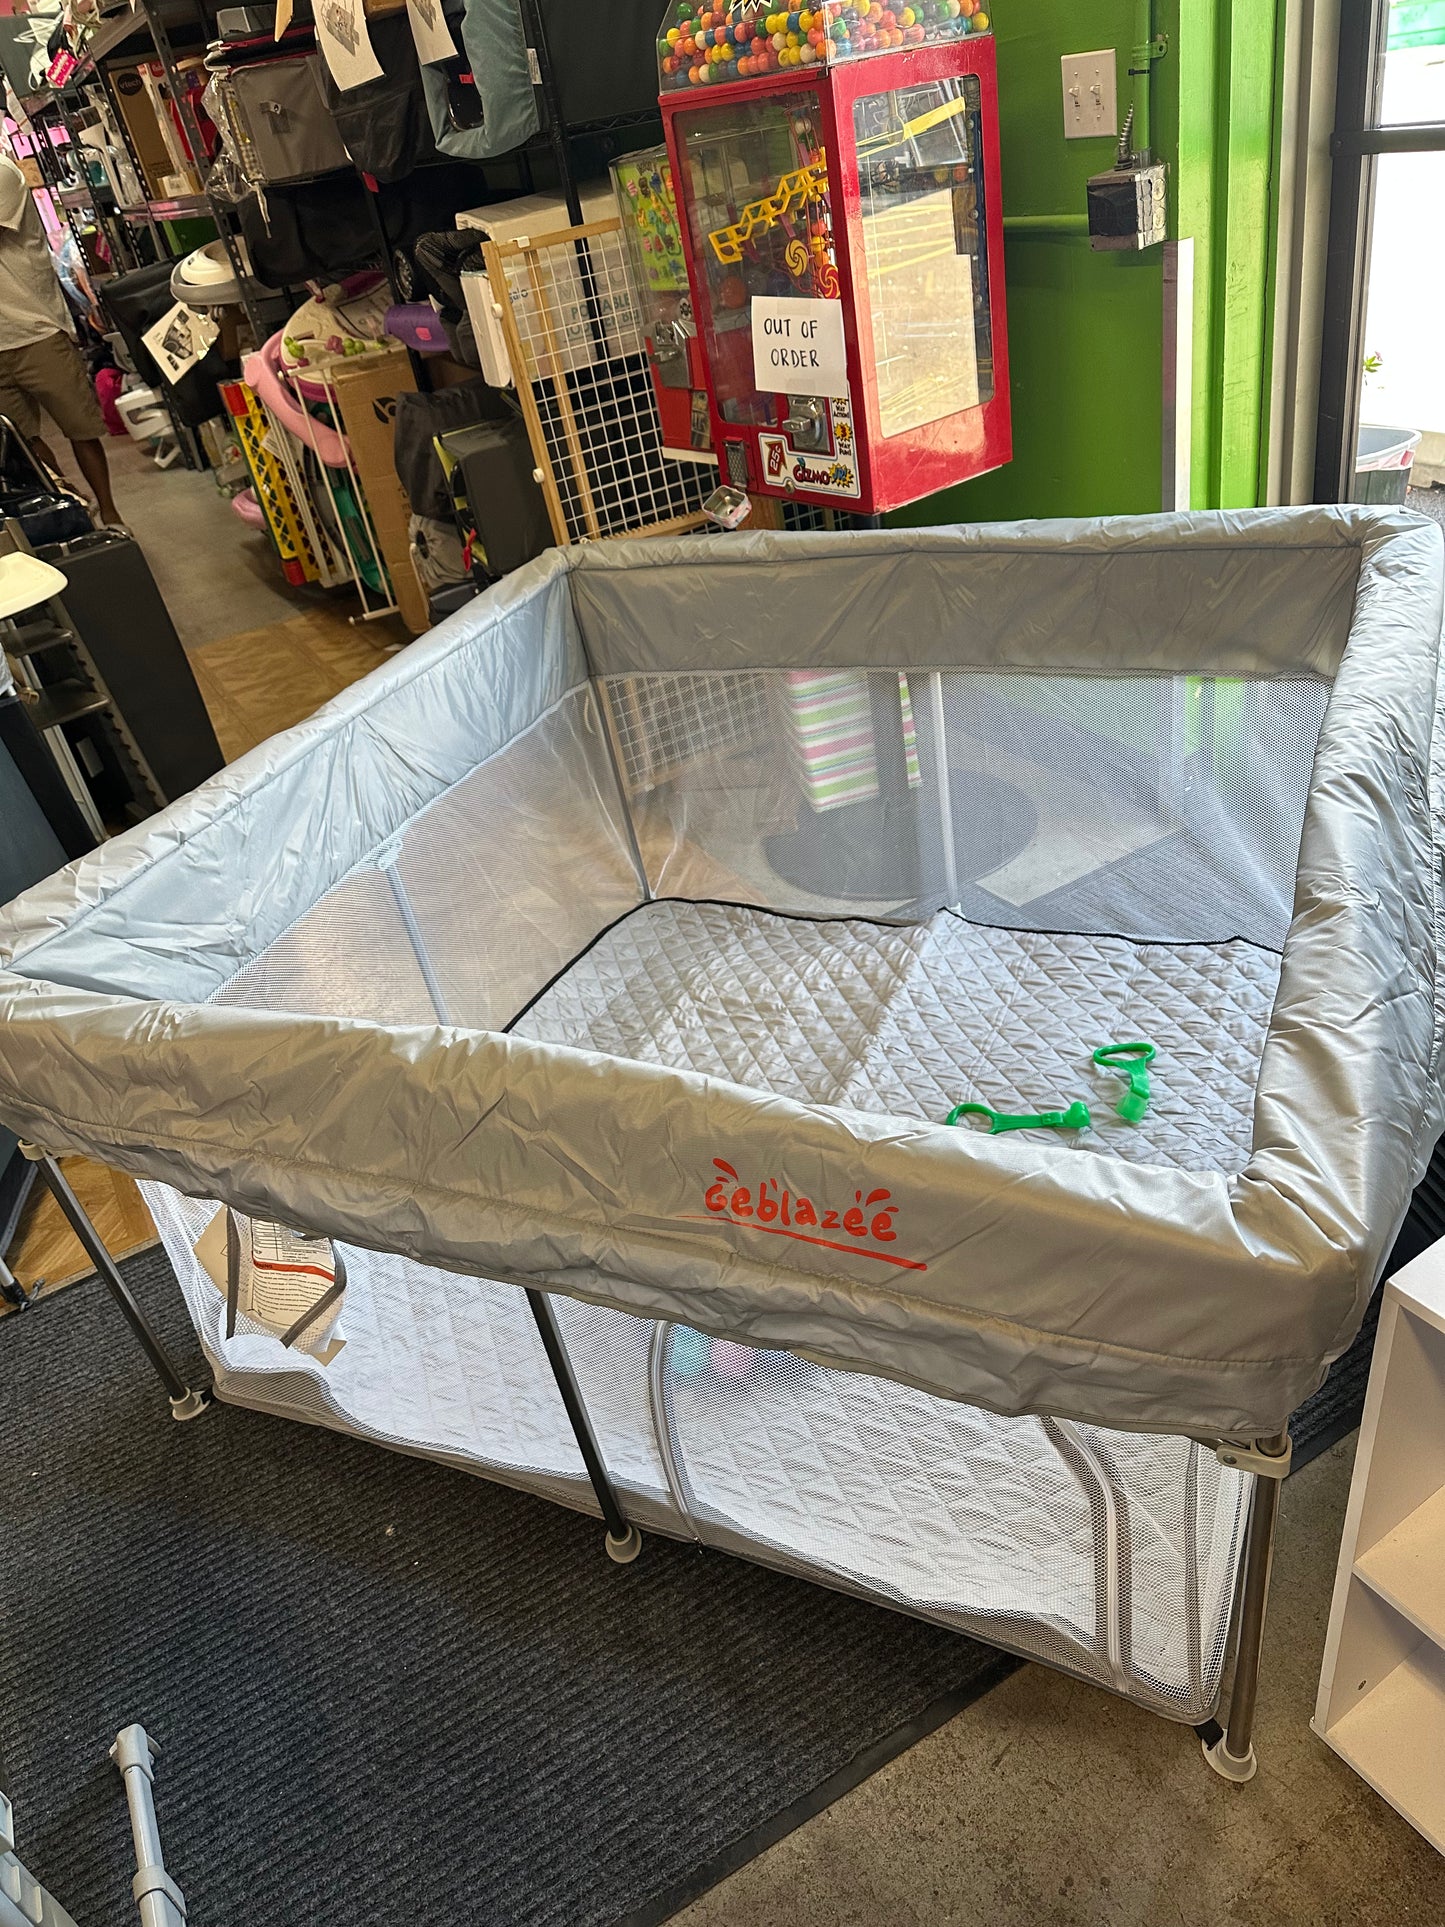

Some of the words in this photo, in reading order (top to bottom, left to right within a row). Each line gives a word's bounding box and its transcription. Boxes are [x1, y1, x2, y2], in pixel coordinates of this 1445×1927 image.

[763, 317, 792, 337] OUT
[801, 319, 818, 339] OF
[770, 347, 820, 368] ORDER
